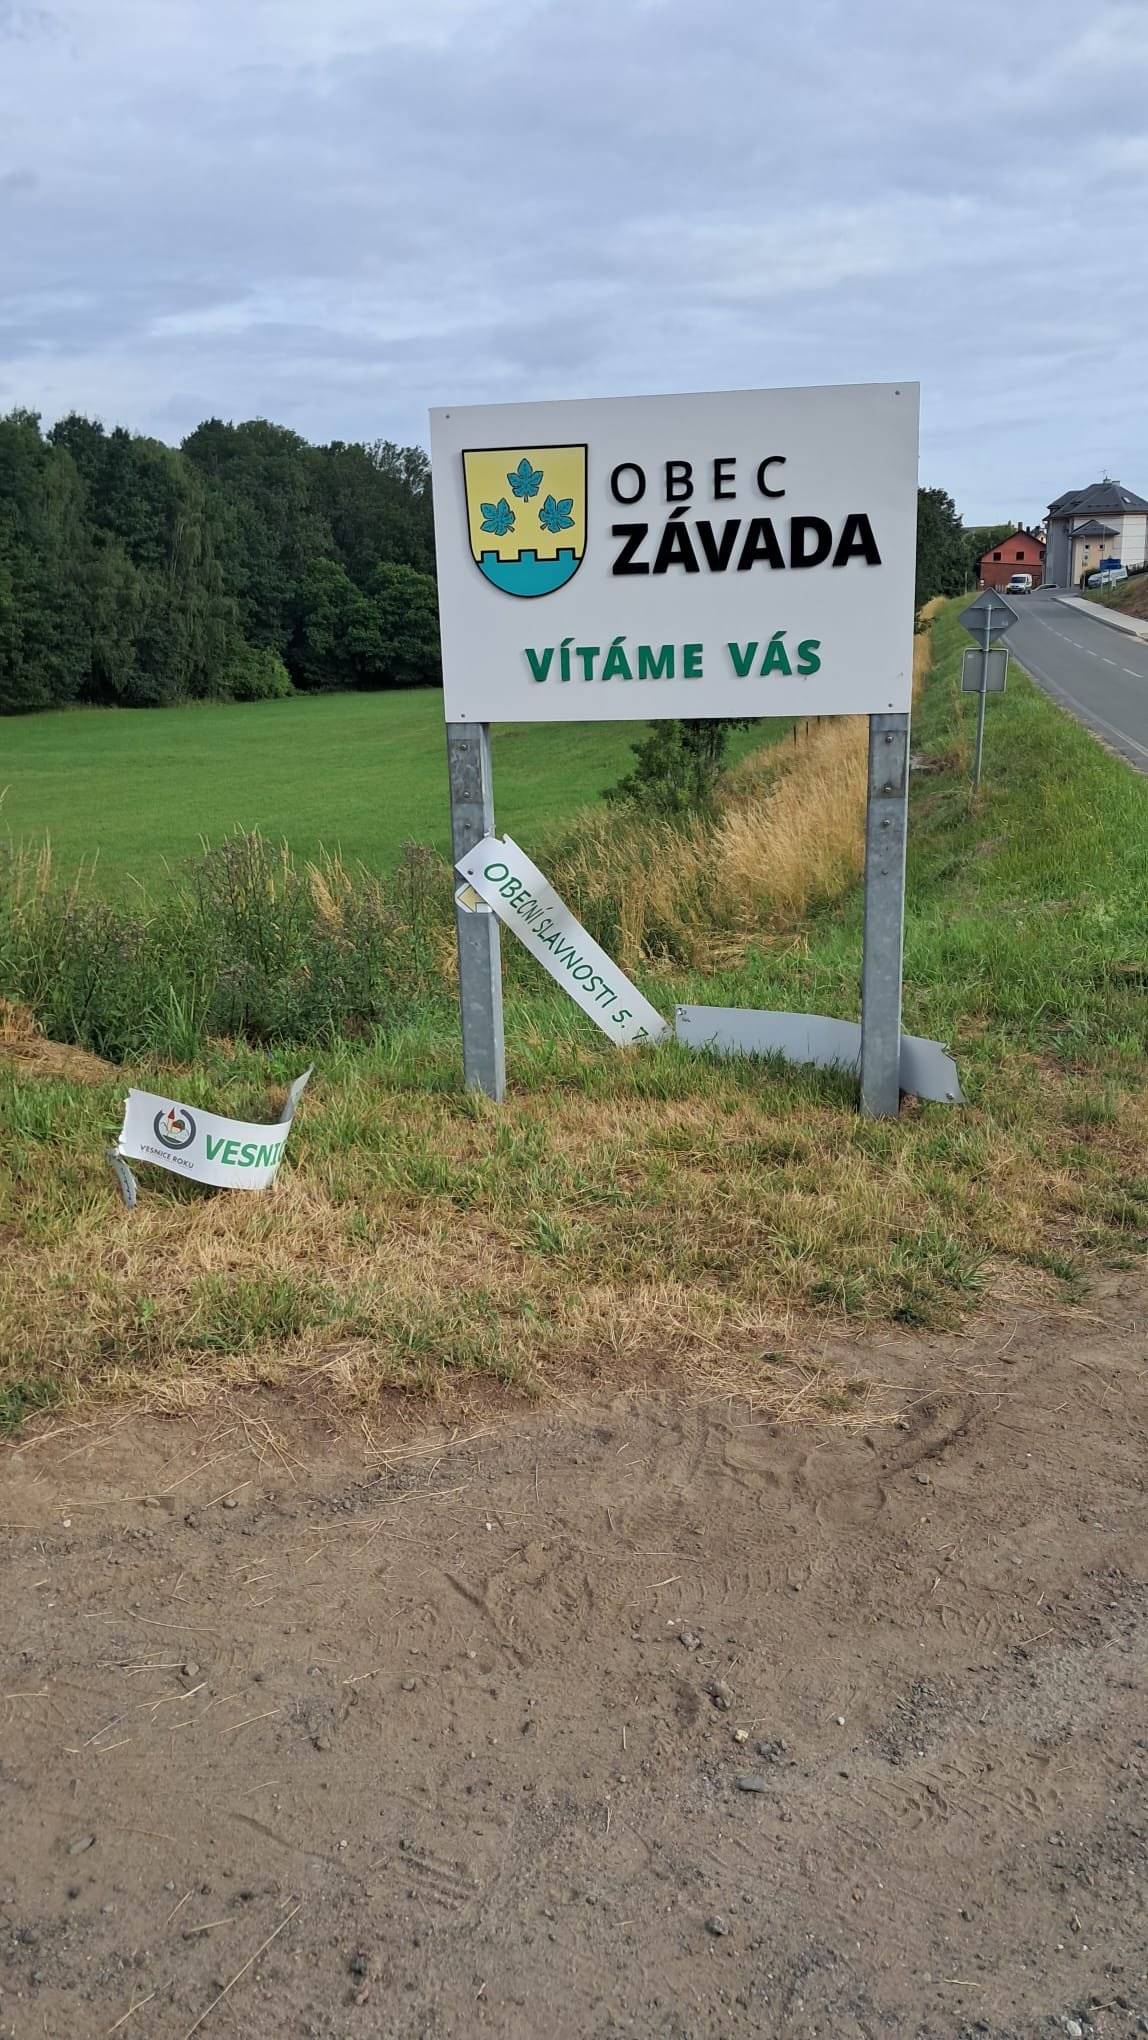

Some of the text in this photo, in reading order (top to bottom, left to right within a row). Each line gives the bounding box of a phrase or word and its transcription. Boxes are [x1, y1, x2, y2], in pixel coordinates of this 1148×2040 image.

[610, 456, 787, 504] OBEC
[611, 506, 882, 576] ZÁVADA
[525, 631, 821, 682] VÍTÁME VÁS
[483, 863, 553, 925] OBECNÍ
[532, 918, 618, 1008] SLAVNOSTI
[140, 1144, 194, 1169] VESNICE ROKU
